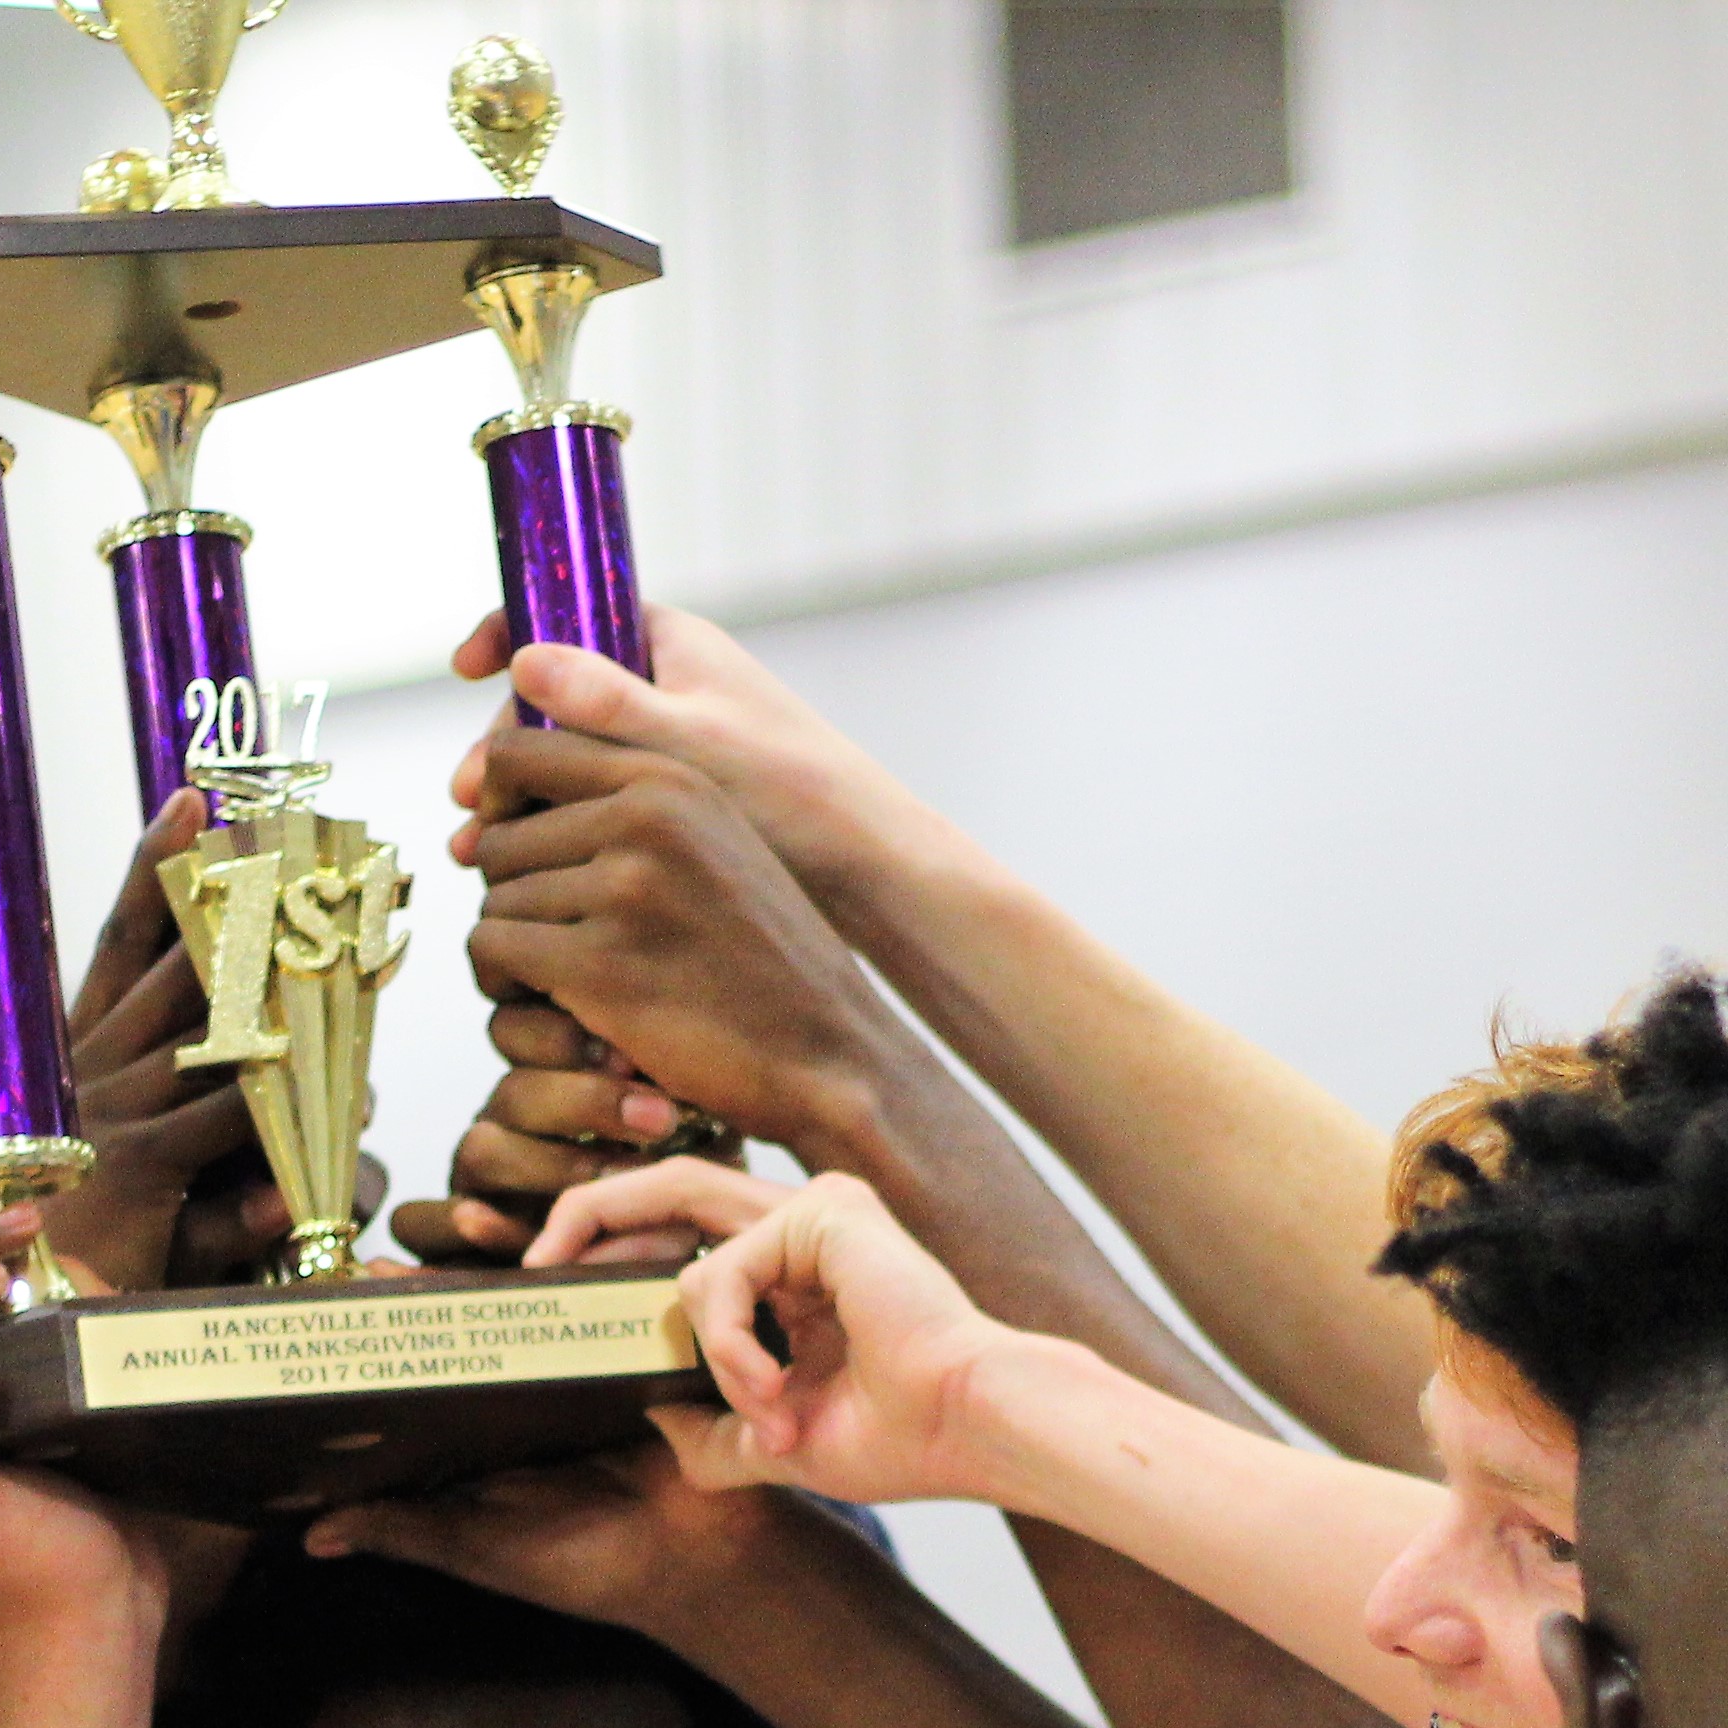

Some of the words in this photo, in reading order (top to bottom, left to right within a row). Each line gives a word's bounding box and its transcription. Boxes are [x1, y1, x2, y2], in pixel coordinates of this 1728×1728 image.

[184, 675, 330, 768] 2017
[202, 1311, 378, 1339] HANCEVILLE
[387, 1306, 453, 1328] HIGH
[462, 1300, 568, 1322] SCHOOL
[122, 1346, 237, 1370] ANNUAL
[245, 1332, 456, 1362] THANKSGIVING
[463, 1318, 653, 1347] TOURNAMENT
[280, 1364, 349, 1386] 2017
[359, 1353, 503, 1380] CHAMPION
